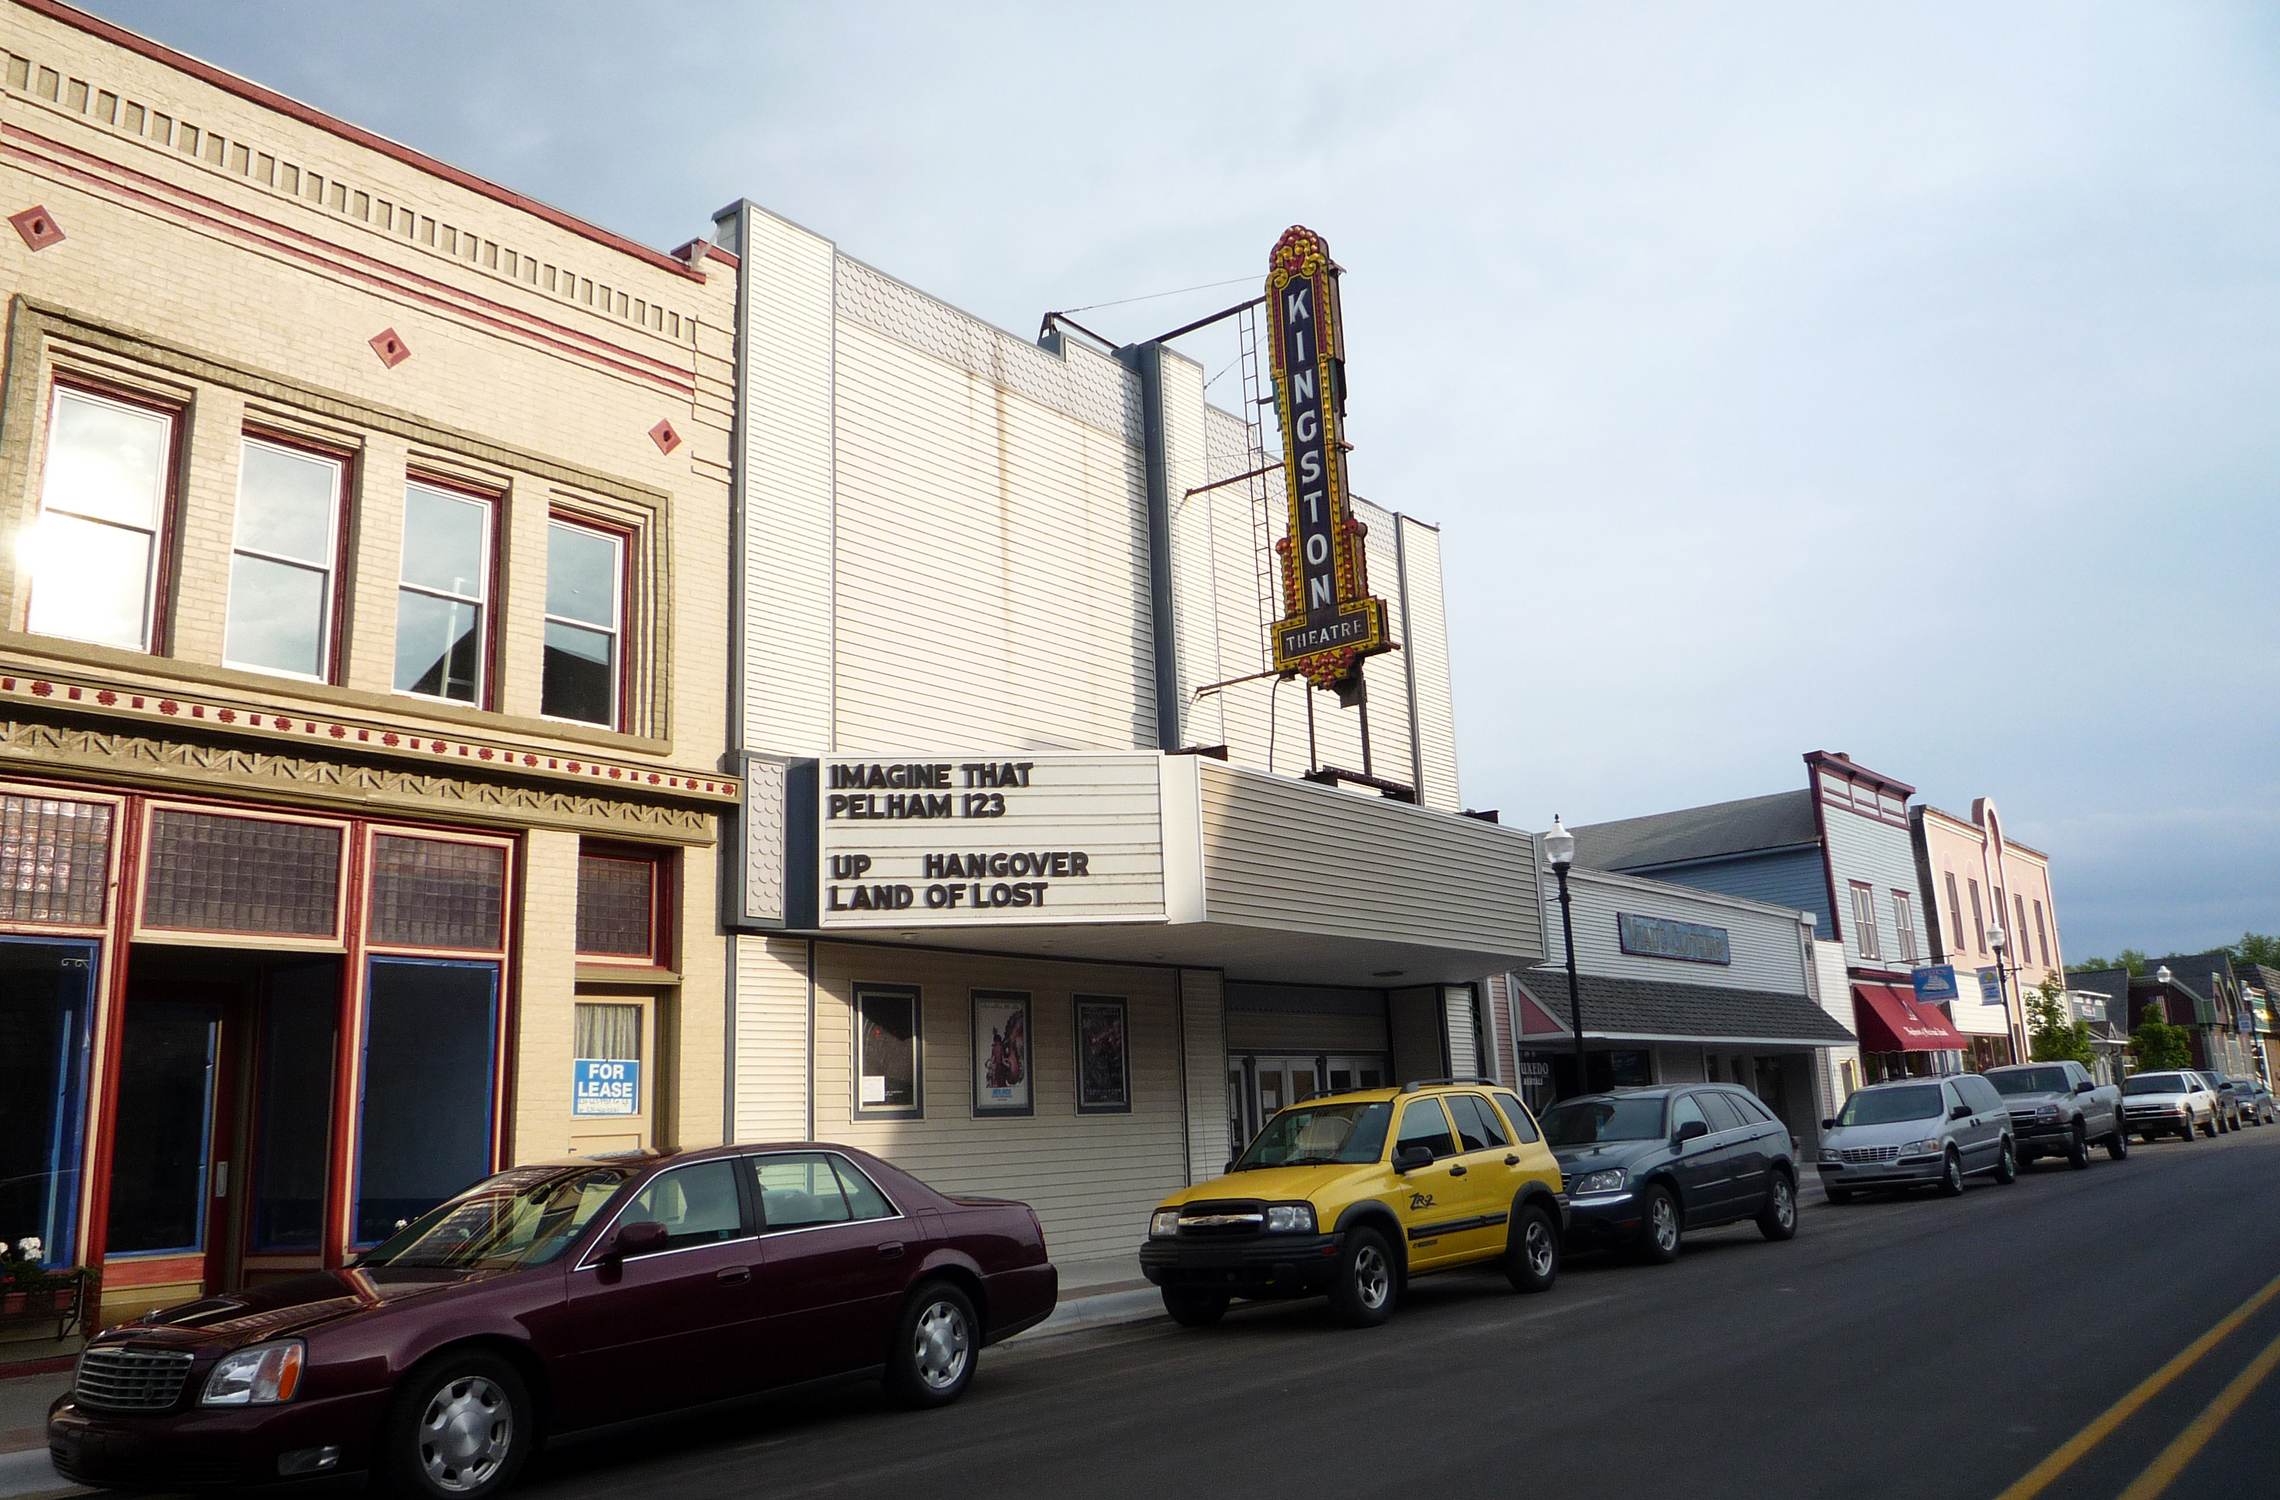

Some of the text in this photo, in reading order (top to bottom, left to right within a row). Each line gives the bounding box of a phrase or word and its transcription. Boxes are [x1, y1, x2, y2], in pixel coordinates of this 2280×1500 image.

[1287, 287, 1331, 610] KINGSTON
[1286, 619, 1364, 651] THEATRE
[830, 761, 1034, 790] IMAGINE THAT
[829, 793, 1006, 820] PELHAM 123
[831, 851, 1090, 880] UP HANGOVER
[828, 881, 1049, 911] LAND OF LOST
[588, 1063, 625, 1080] FOR
[1519, 1062, 1549, 1075] UXEDO
[578, 1081, 633, 1098] LEASE
